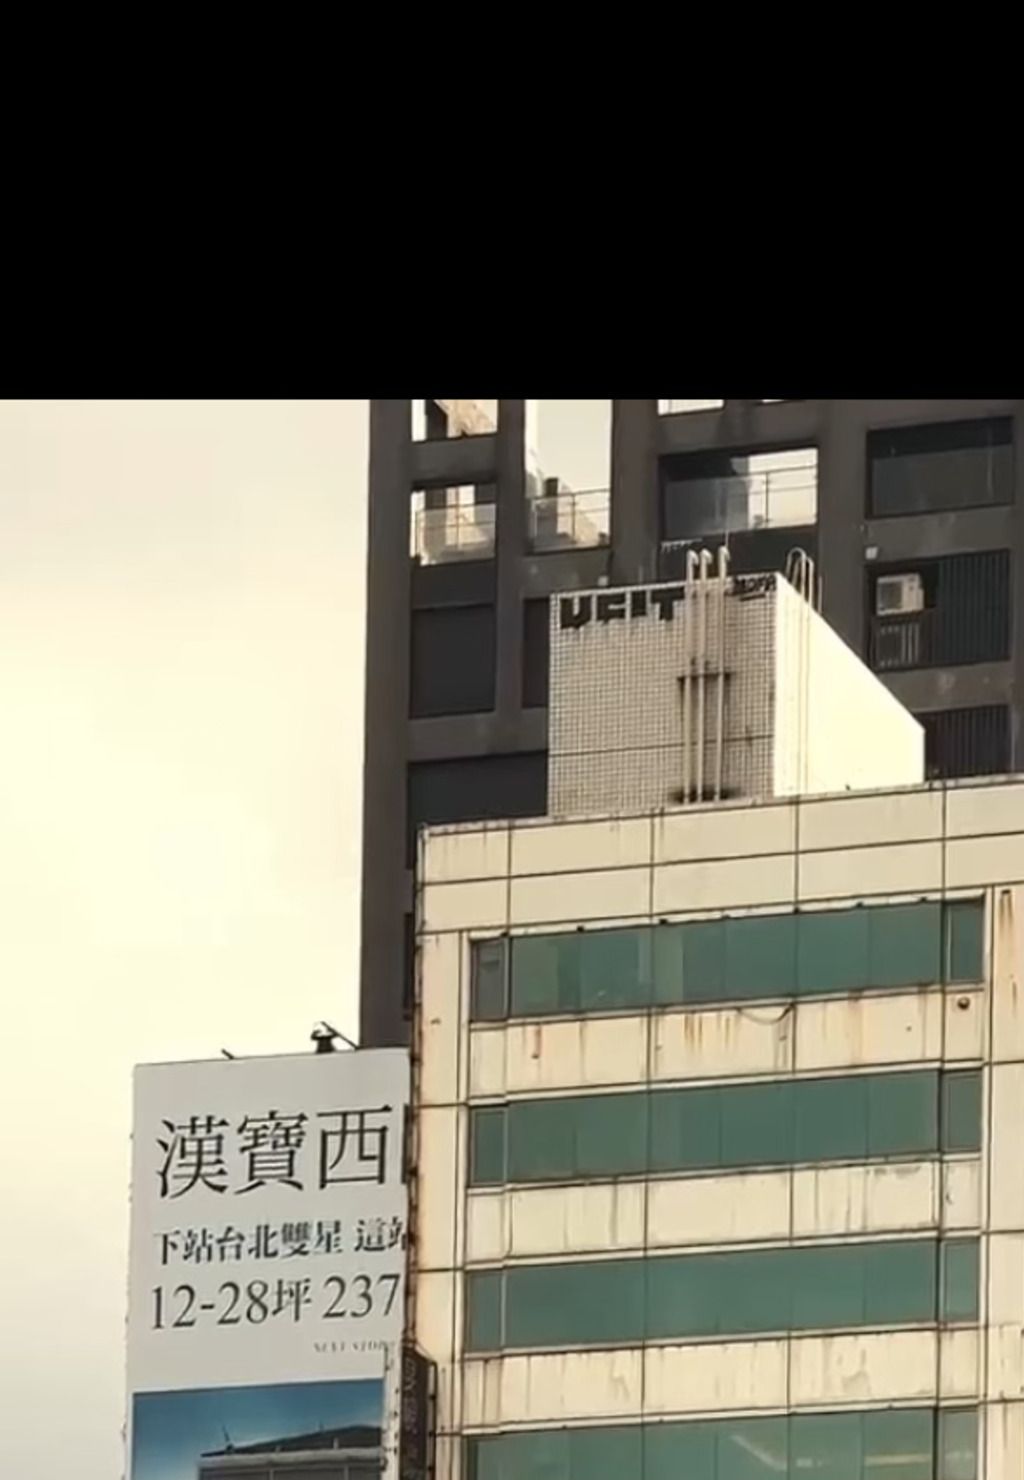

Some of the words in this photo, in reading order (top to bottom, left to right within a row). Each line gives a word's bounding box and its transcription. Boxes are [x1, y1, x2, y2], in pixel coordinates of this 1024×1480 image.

[156, 1104, 408, 1199] 漢寶西
[153, 1220, 343, 1265] 下站台北雙星
[151, 1277, 312, 1330] 12-28坪
